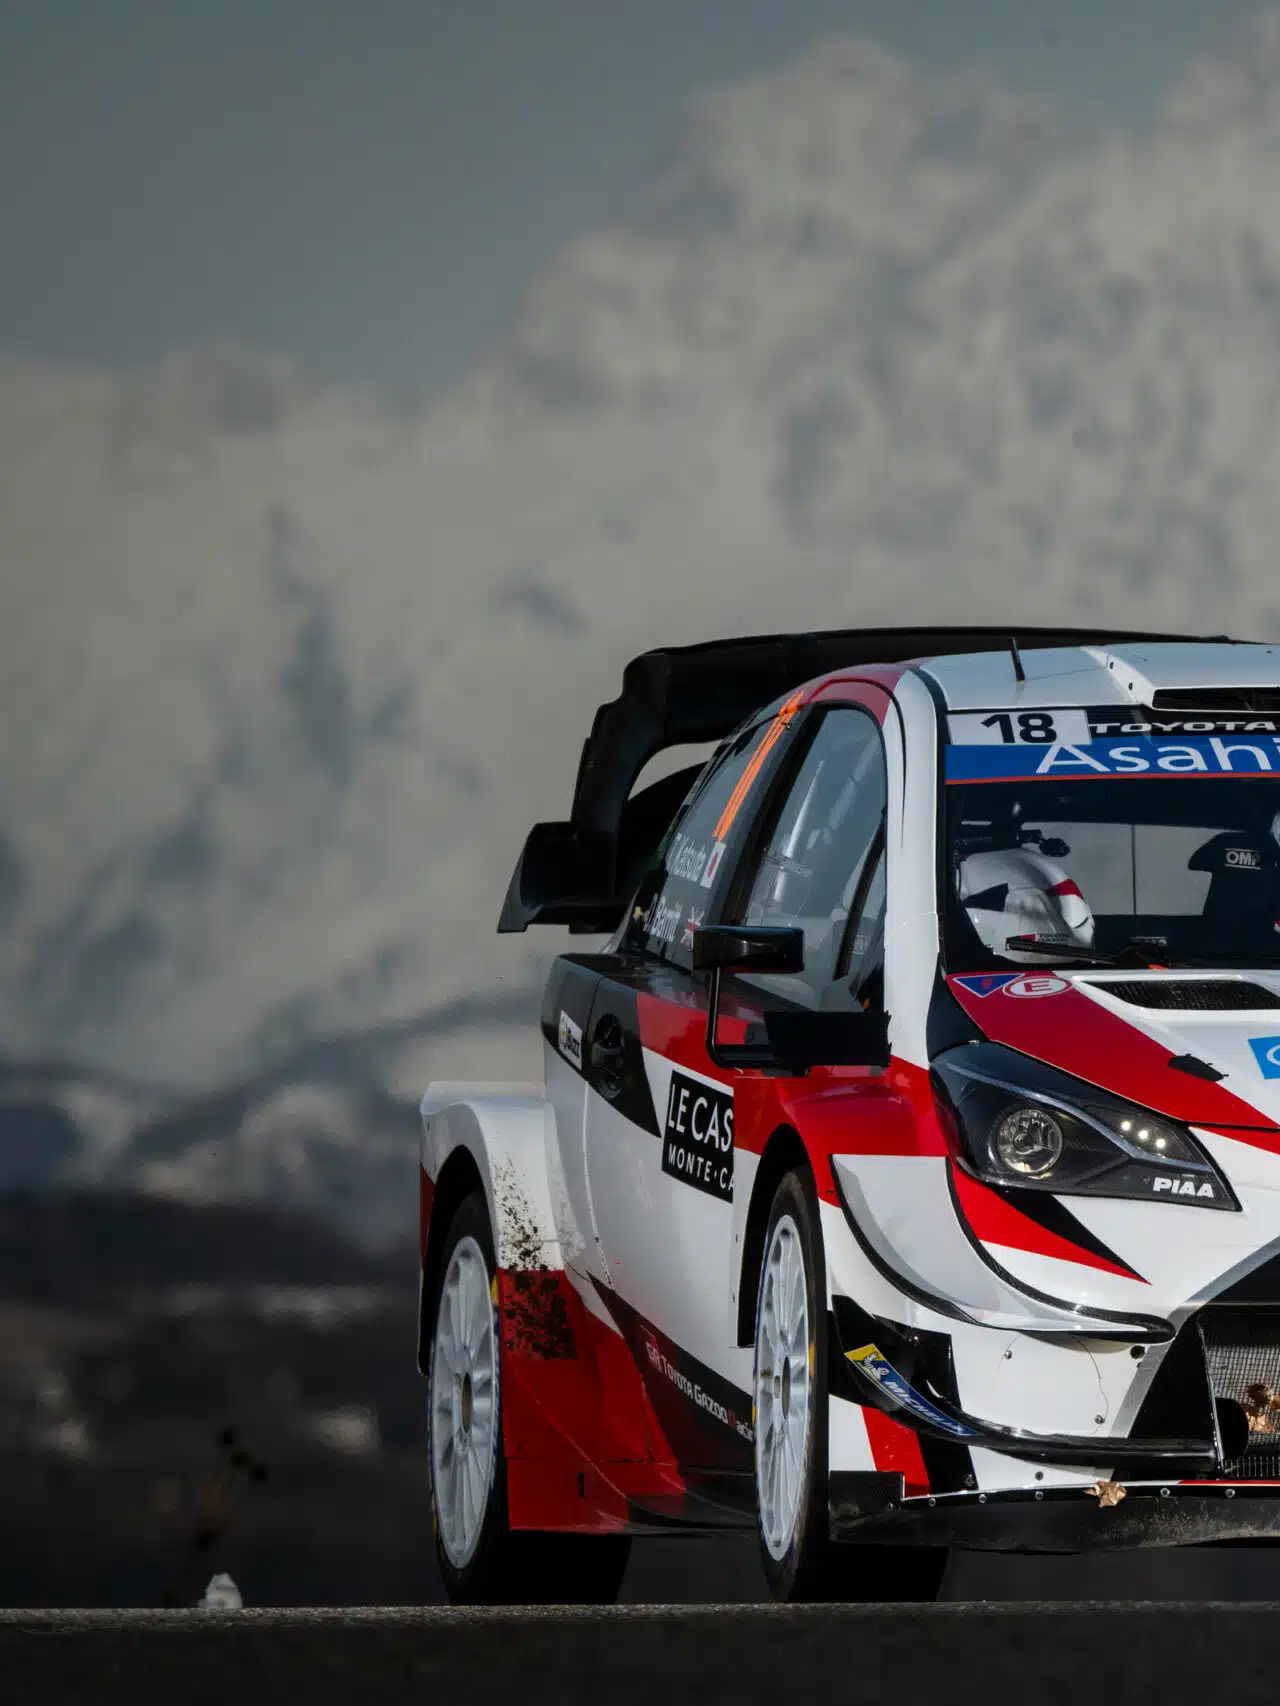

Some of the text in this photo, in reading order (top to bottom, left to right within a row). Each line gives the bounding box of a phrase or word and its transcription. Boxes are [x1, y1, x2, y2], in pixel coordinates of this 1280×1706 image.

[981, 712, 1057, 744] 18
[1089, 720, 1276, 734] TOYOTA
[668, 1084, 734, 1153] LE CAS
[1153, 1177, 1214, 1198] PIAA
[660, 1354, 693, 1399] TOYOTA
[693, 1383, 729, 1425] GAZOO
